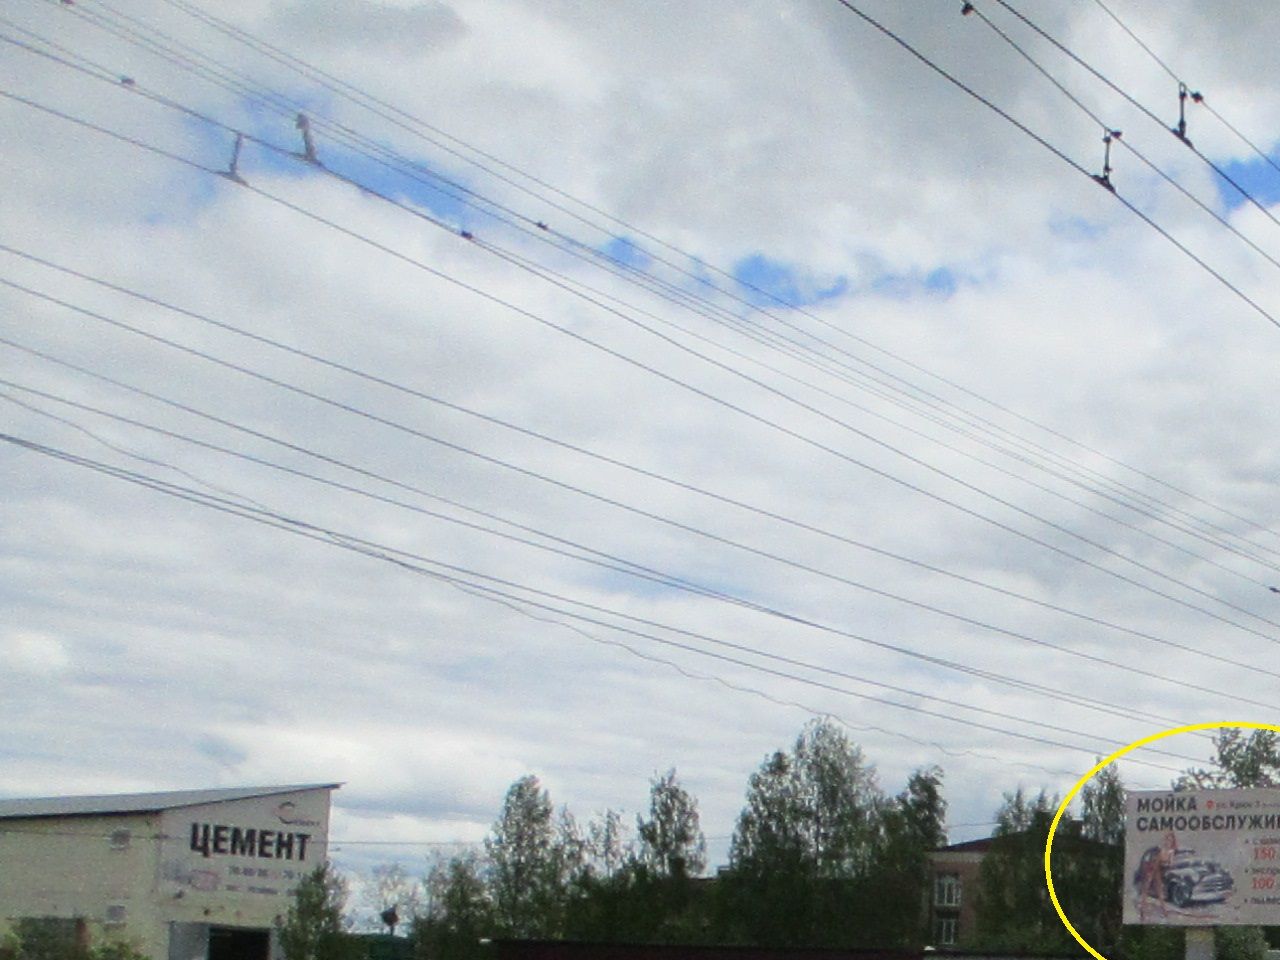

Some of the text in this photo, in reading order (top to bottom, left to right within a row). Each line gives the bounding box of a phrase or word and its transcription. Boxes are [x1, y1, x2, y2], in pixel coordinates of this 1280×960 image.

[1137, 794, 1197, 813] МОЙКА
[190, 822, 312, 861] ЦЕМЕНТ
[1254, 846, 1276, 860] 150
[1252, 877, 1275, 890] 100
